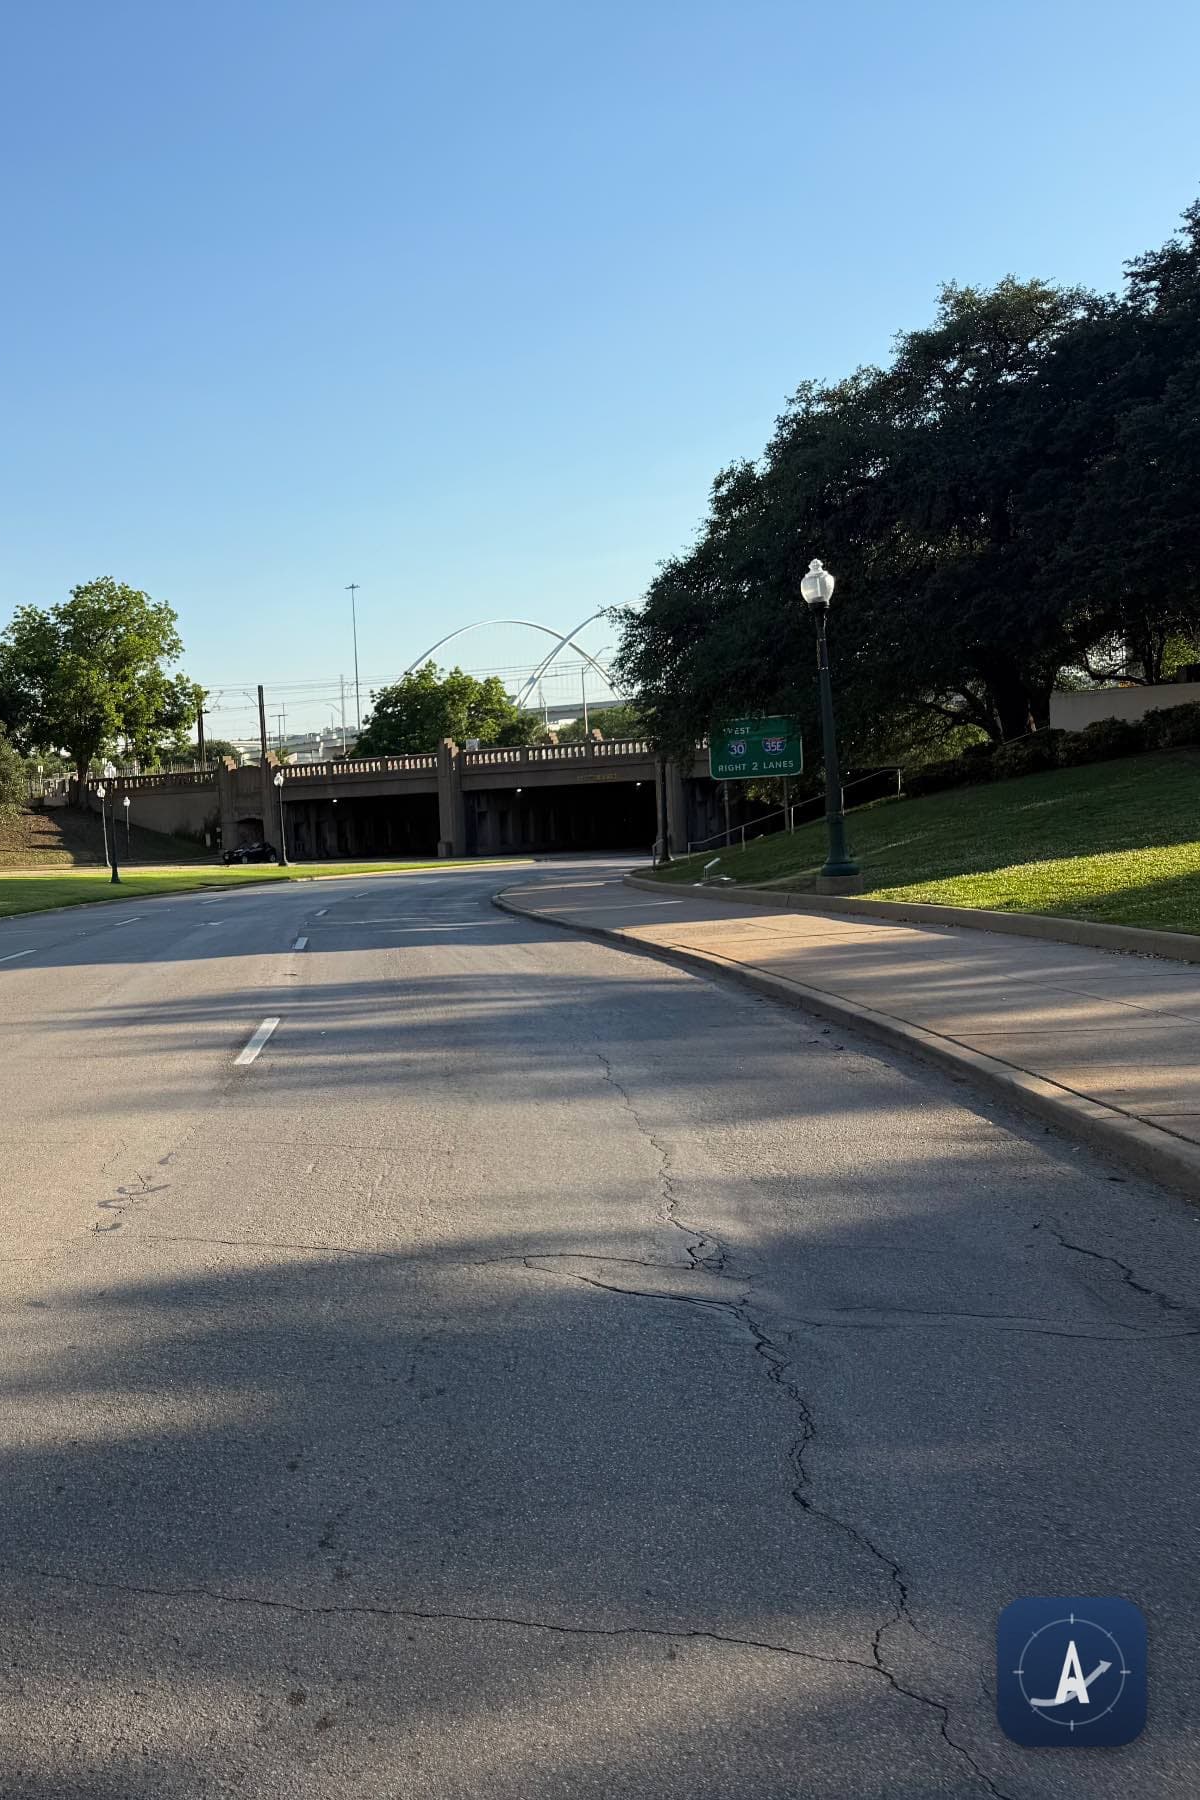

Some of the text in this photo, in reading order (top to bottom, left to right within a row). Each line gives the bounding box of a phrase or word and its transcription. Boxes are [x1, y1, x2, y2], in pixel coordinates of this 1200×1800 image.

[730, 745, 745, 755] 30
[765, 741, 783, 752] 35E
[718, 761, 794, 772] RIGHT 2 LANES
